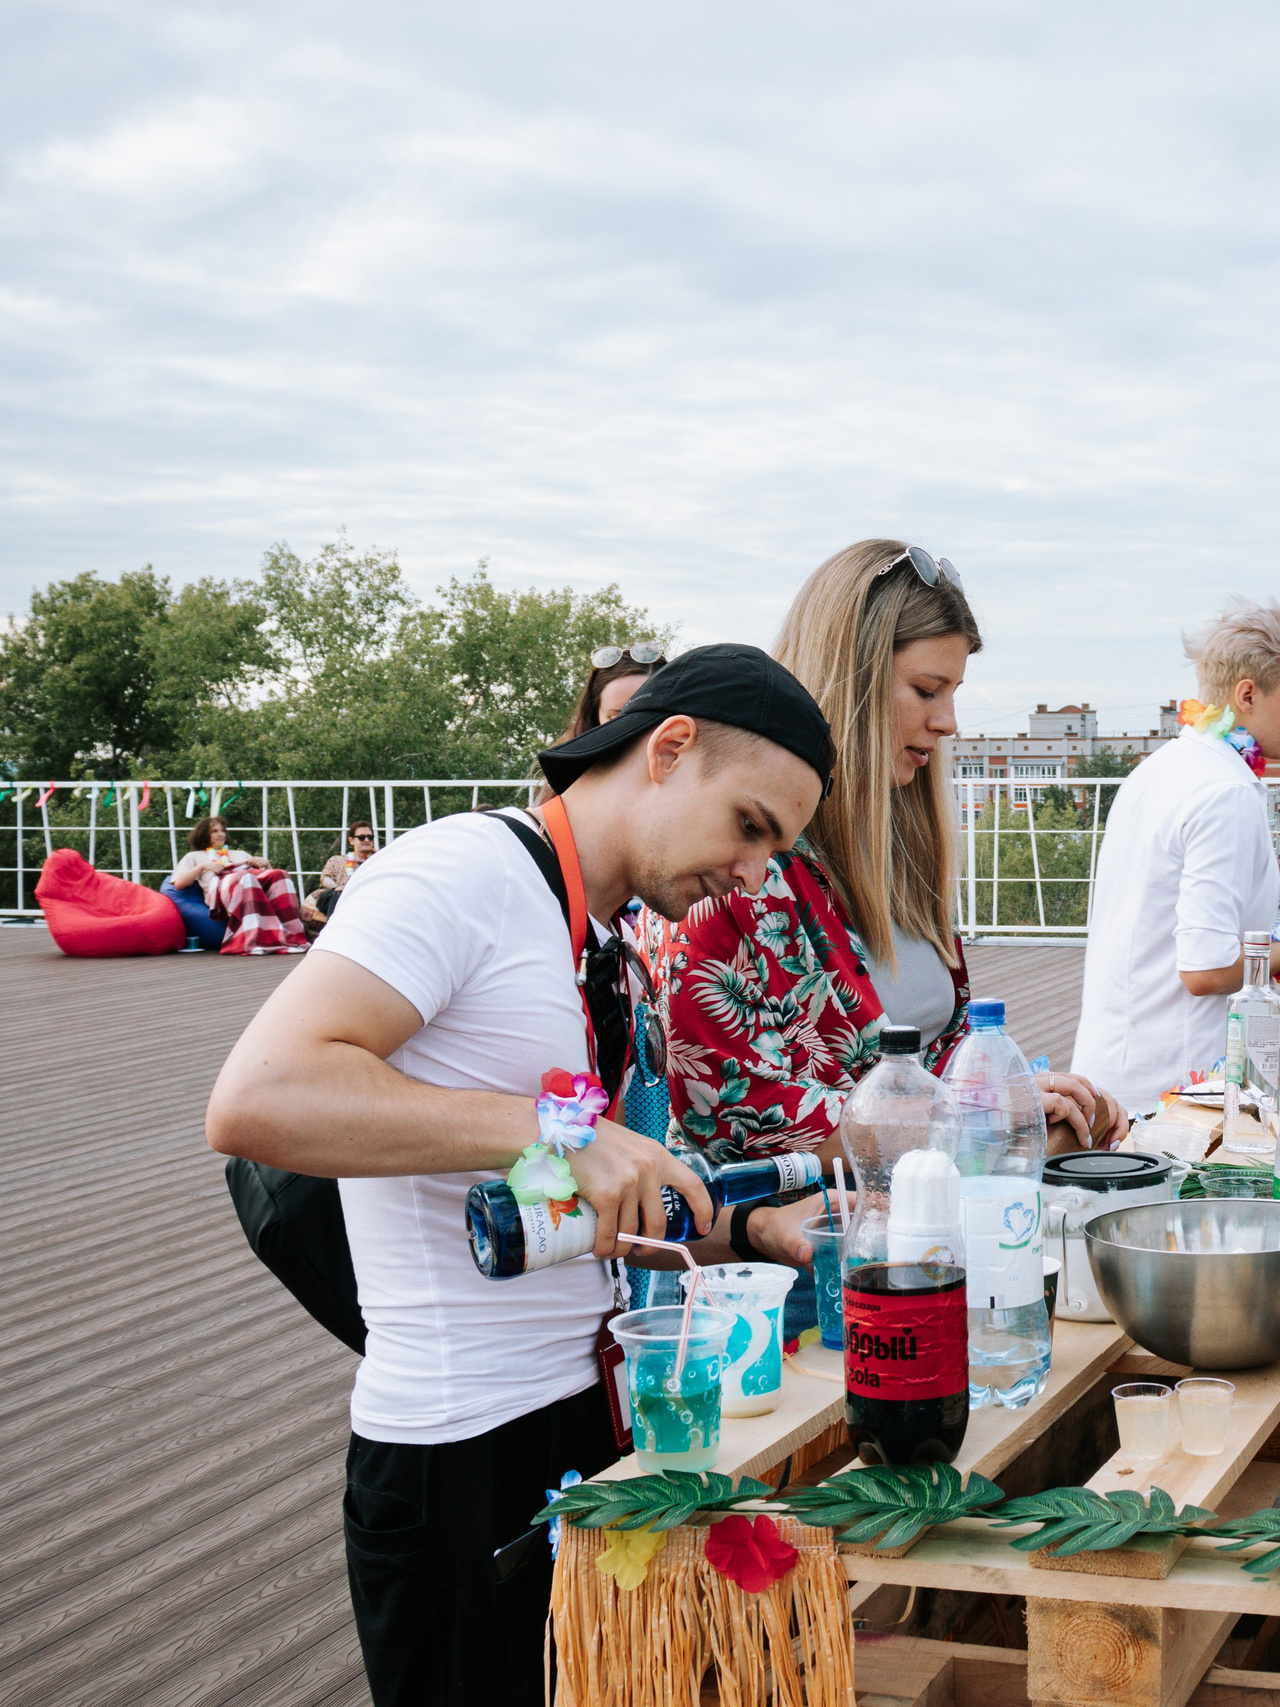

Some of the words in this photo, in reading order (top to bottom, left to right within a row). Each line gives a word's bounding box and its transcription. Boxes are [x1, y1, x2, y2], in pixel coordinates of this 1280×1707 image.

[532, 1202, 548, 1254] URAÇAO
[855, 1301, 881, 1313] сахара
[843, 1322, 917, 1362] обрый
[848, 1366, 880, 1388] cola
